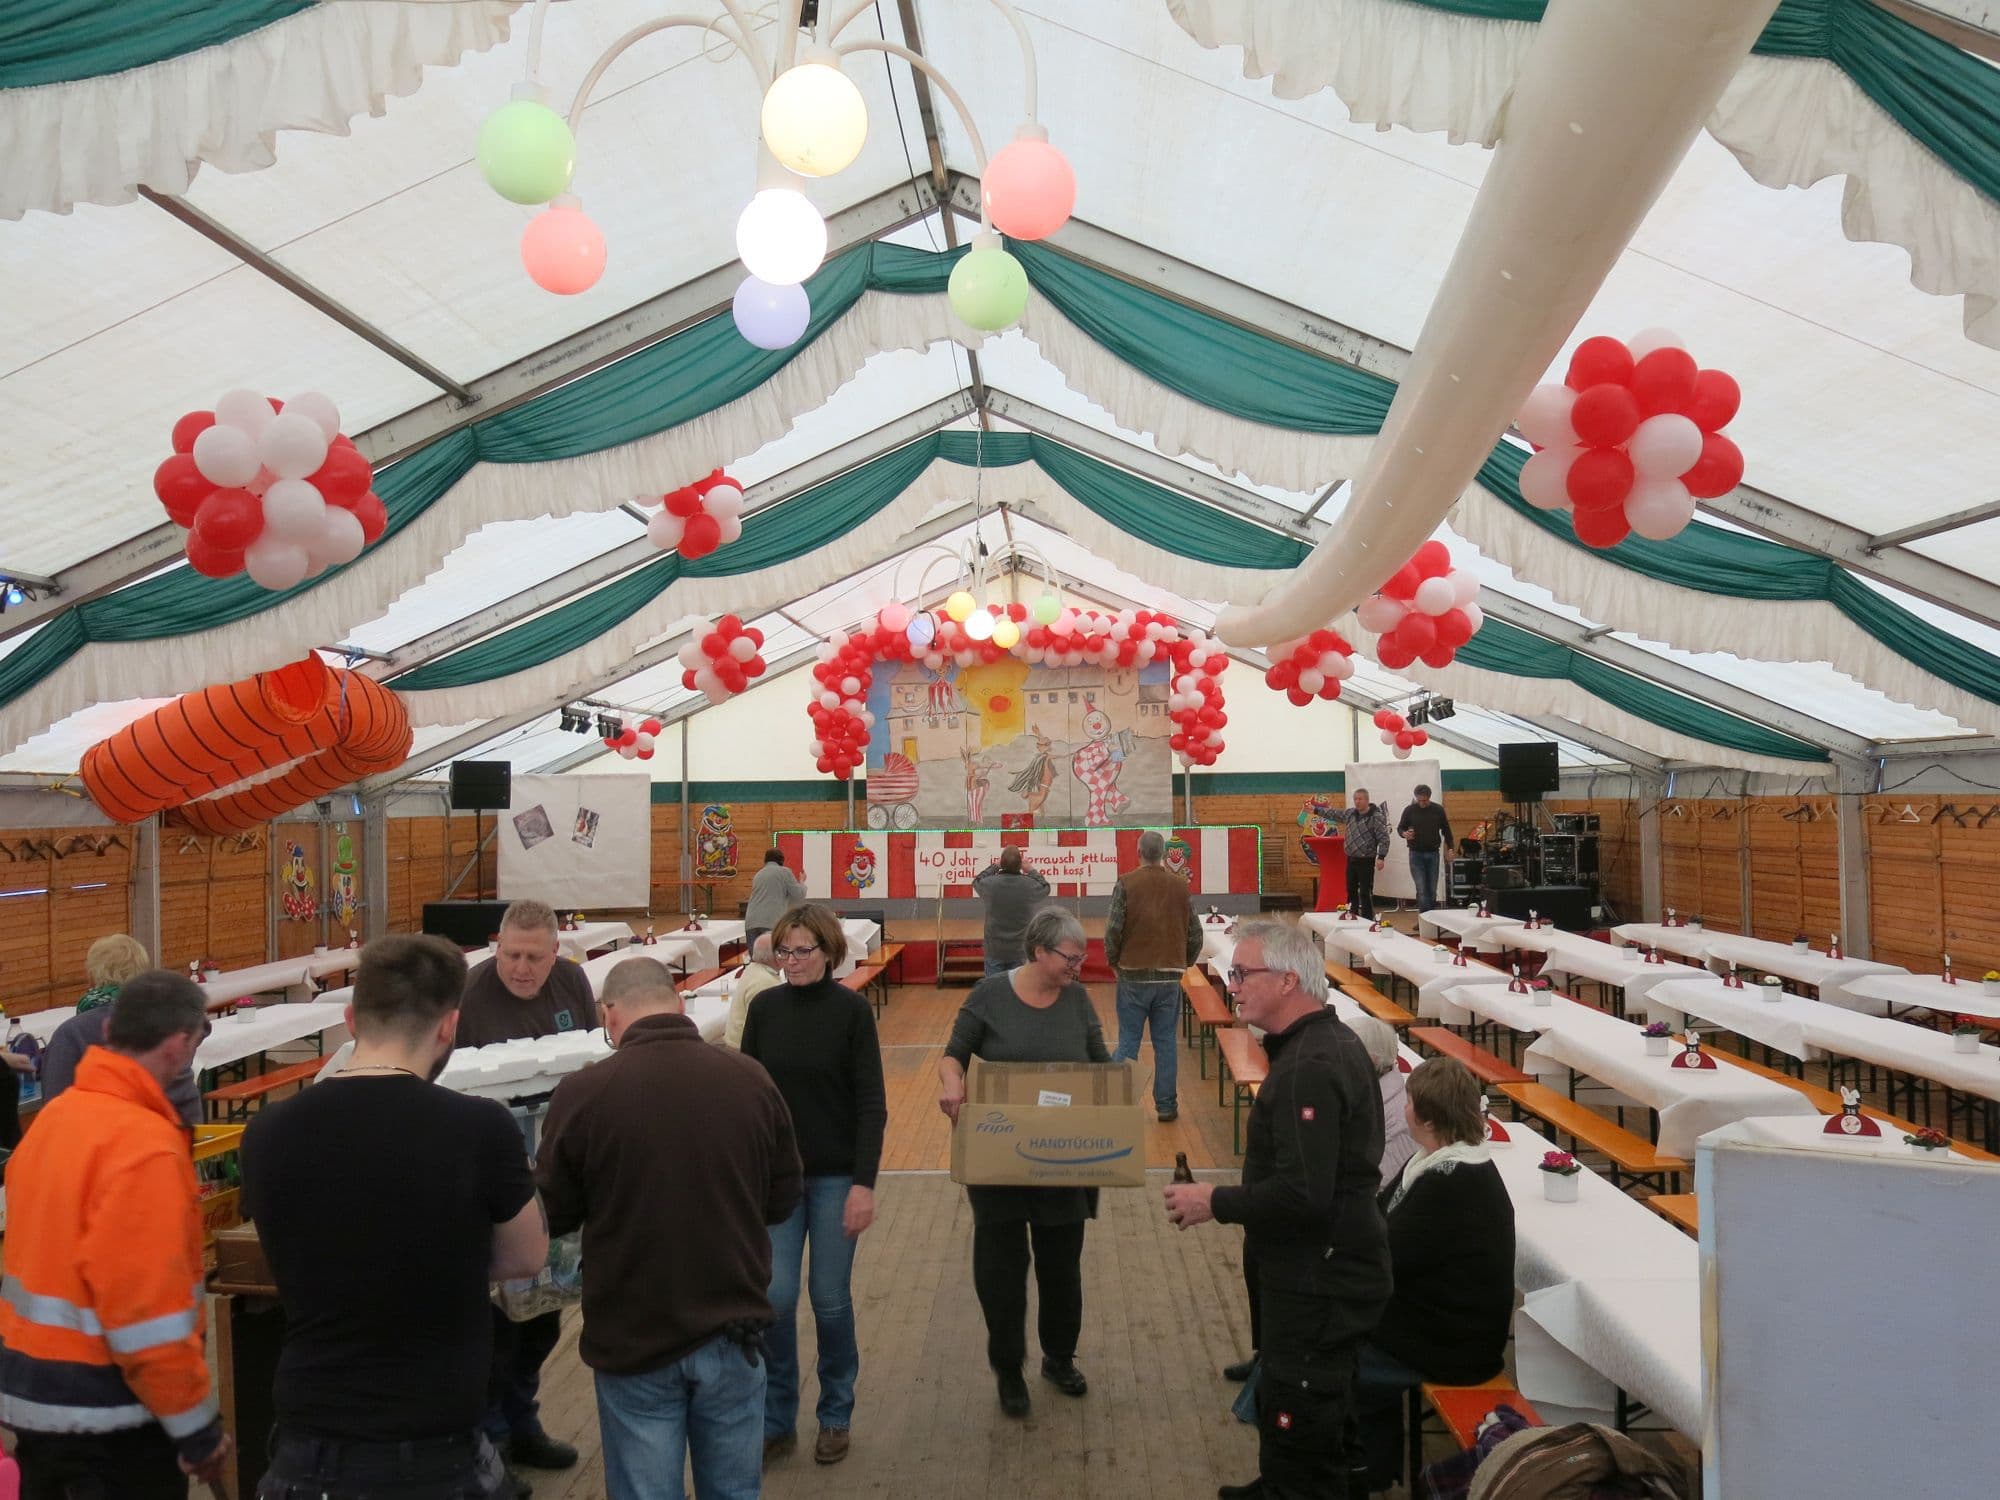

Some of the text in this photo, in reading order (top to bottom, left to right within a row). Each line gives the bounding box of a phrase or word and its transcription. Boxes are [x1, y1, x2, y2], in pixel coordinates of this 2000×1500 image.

[919, 851, 946, 868] 40
[950, 850, 979, 867] Johr
[1029, 1136, 1114, 1150] HANDTÜCHER
